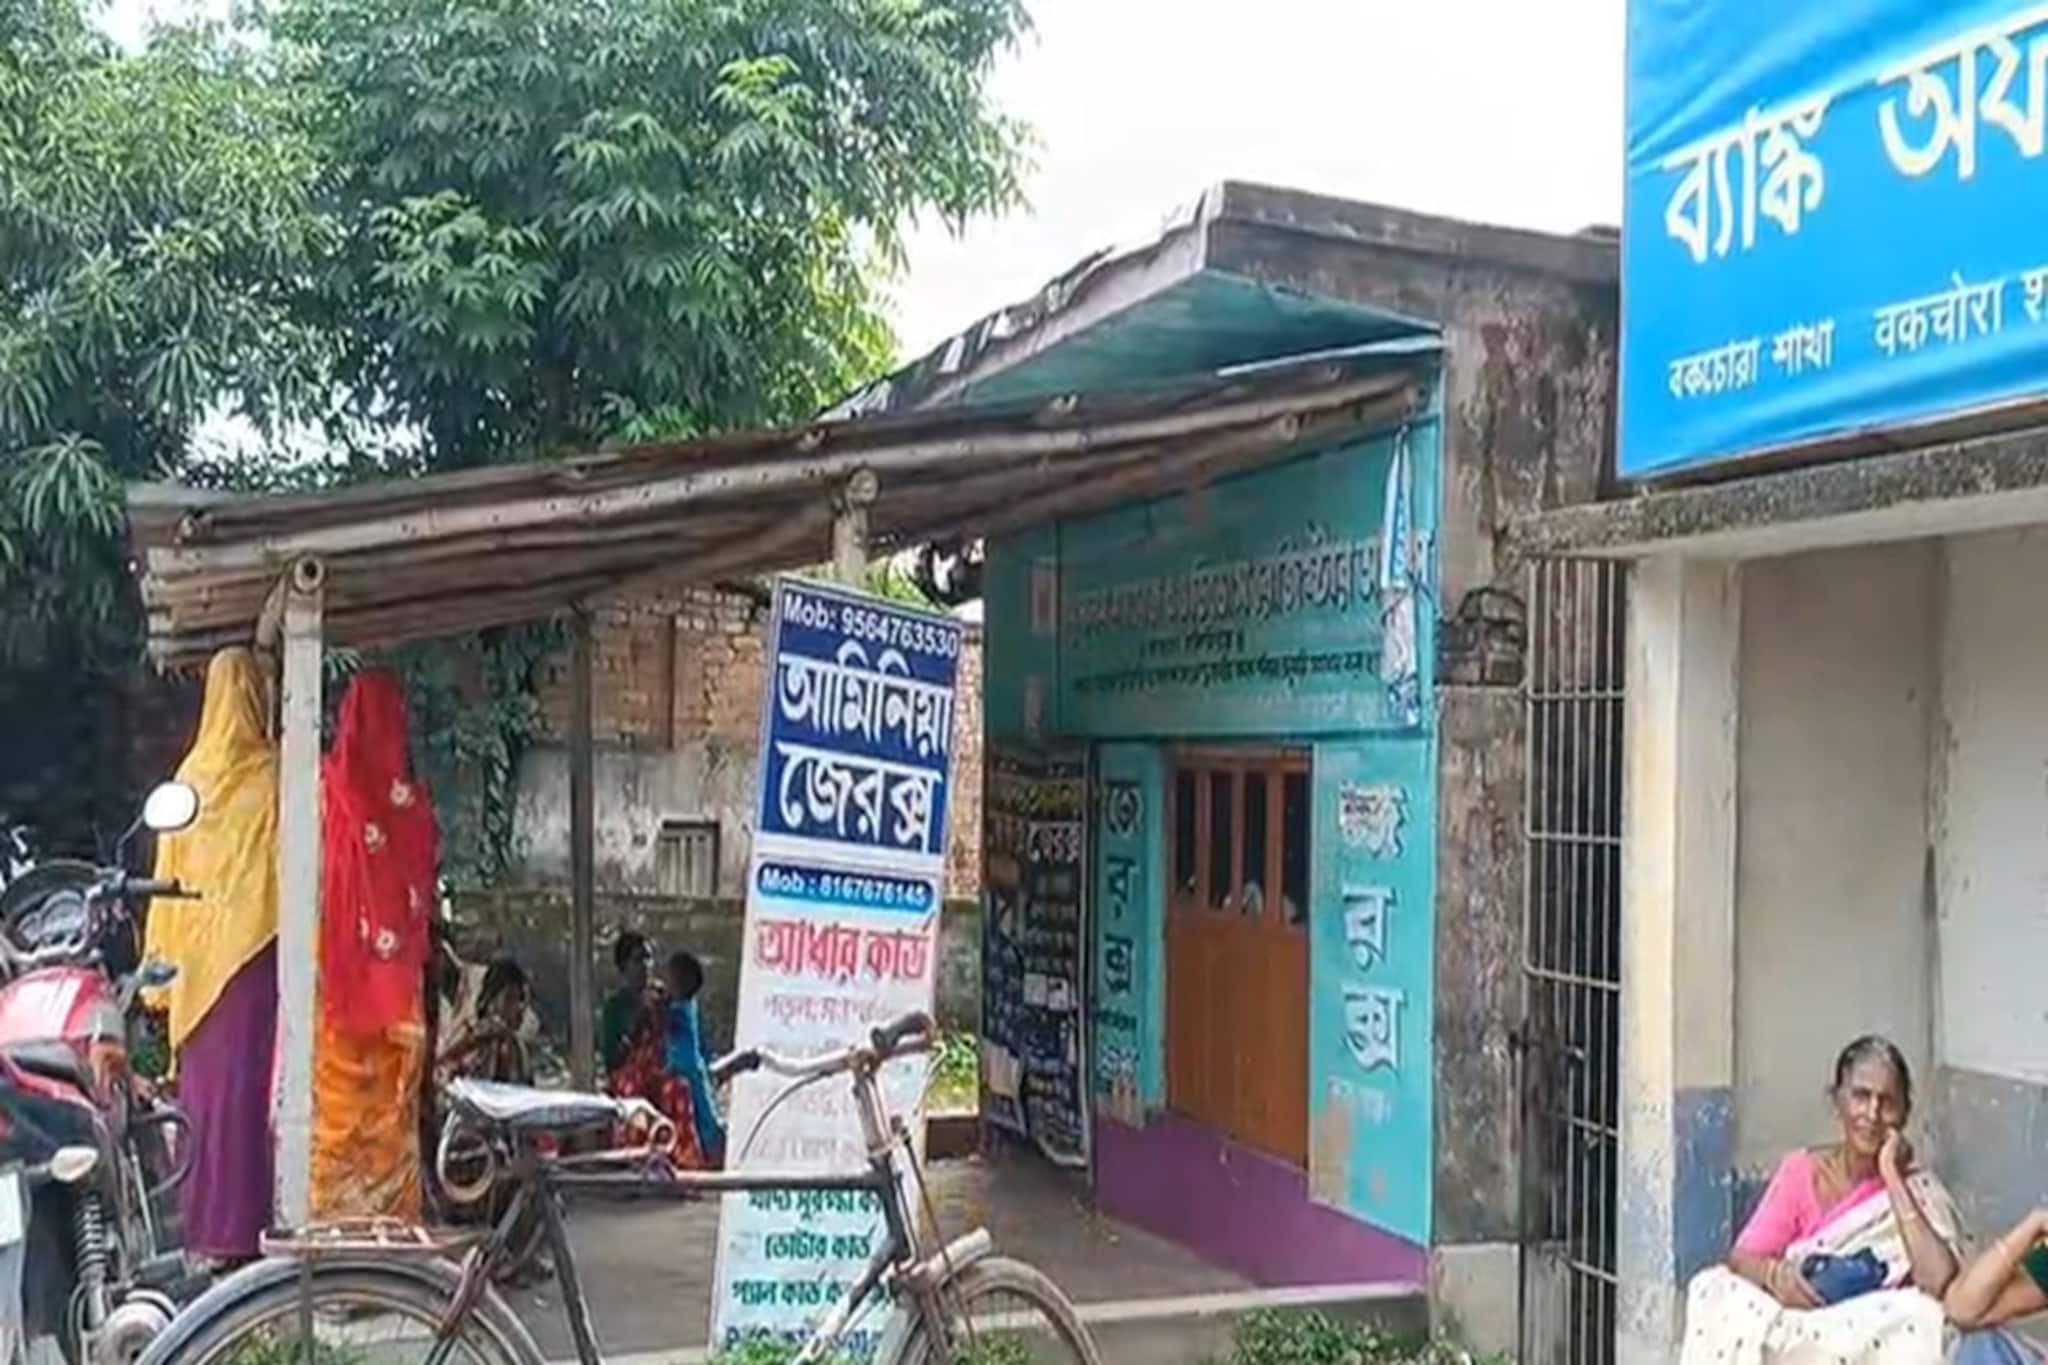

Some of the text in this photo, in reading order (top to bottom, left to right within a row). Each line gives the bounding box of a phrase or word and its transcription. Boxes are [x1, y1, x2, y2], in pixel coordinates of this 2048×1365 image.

[1772, 319, 1835, 376] শাখা
[784, 593, 958, 660] Mob: 9564763530
[778, 640, 953, 759] আমিনিয়া
[775, 742, 943, 856] জেরক্স
[867, 910, 936, 980] কার্ড
[765, 1223, 878, 1261] ভোটার কার্ড
[782, 1269, 827, 1307] কার্ড
